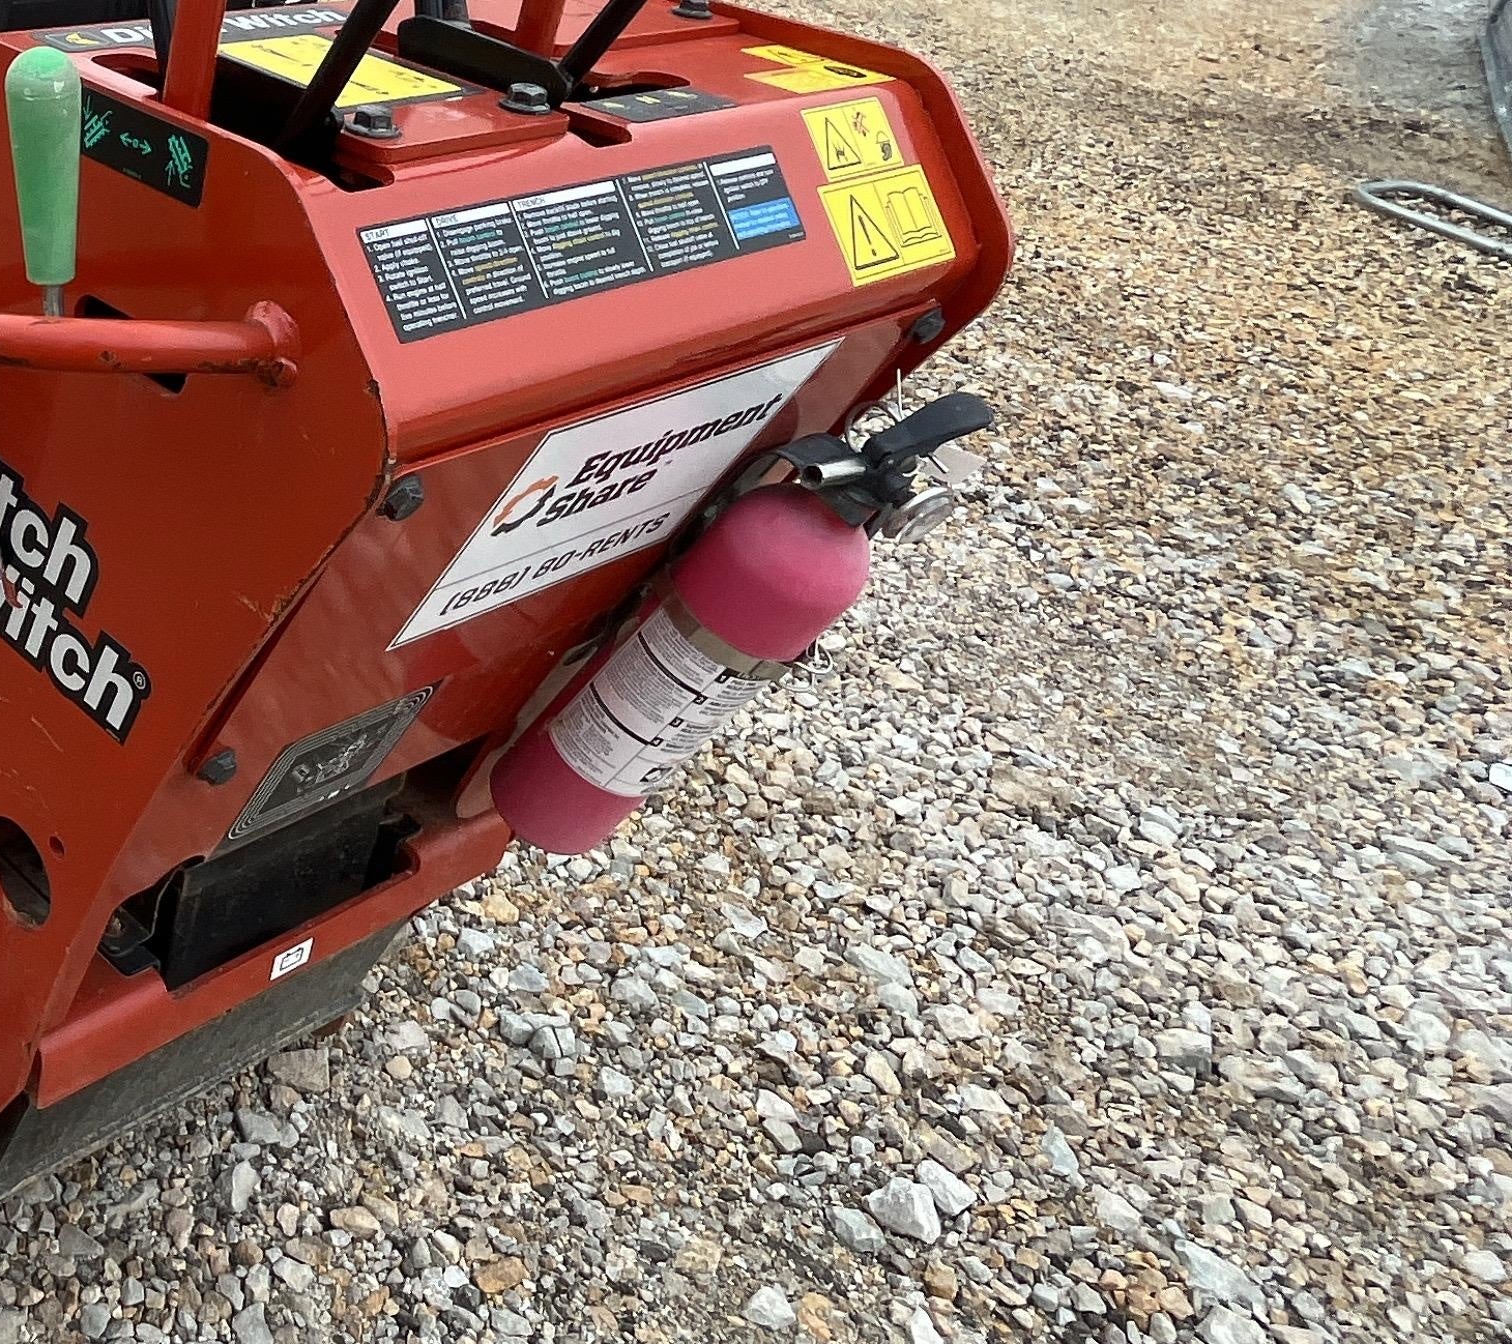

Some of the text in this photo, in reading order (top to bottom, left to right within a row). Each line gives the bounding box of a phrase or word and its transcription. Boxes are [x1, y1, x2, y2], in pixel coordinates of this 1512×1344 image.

[223, 8, 349, 33] Witch
[363, 229, 389, 239] START
[565, 392, 783, 489] Equipment
[536, 468, 658, 528] Share
[439, 512, 670, 616] (888) 80-RENTS
